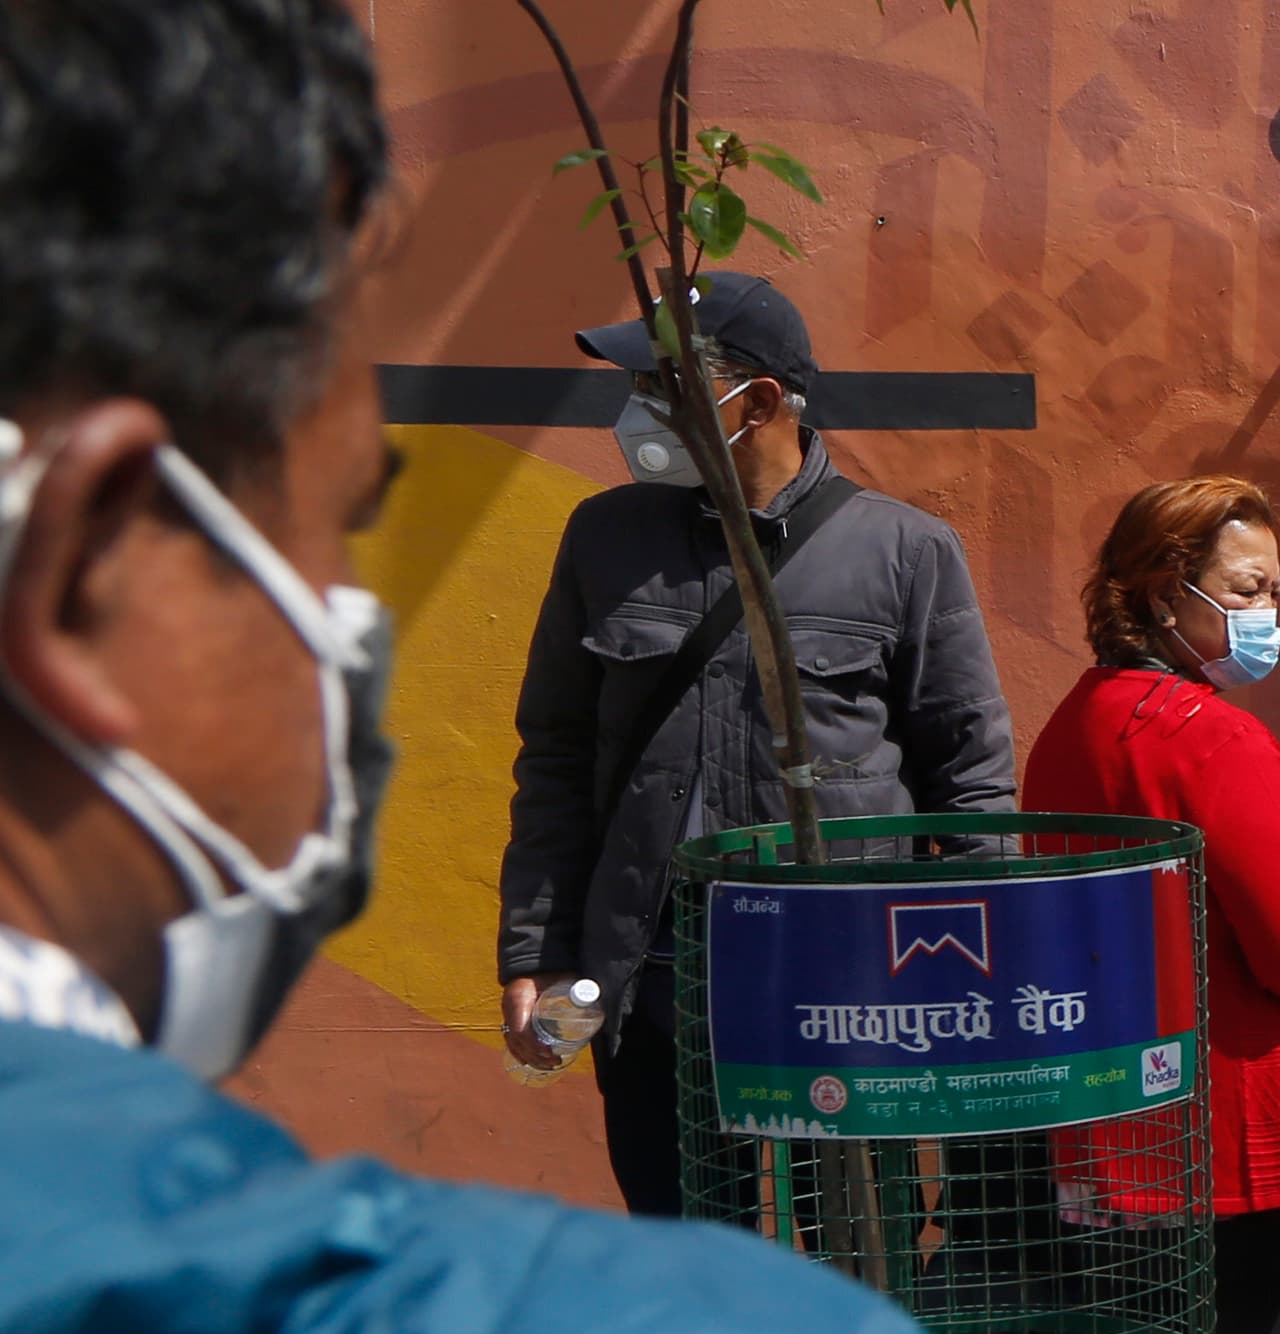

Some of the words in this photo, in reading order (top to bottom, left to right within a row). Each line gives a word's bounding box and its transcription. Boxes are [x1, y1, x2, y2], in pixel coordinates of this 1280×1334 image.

[1011, 984, 1087, 1035] बैंक
[946, 1064, 1071, 1091] महानगरपालिका
[1145, 1067, 1179, 1086] Khadka
